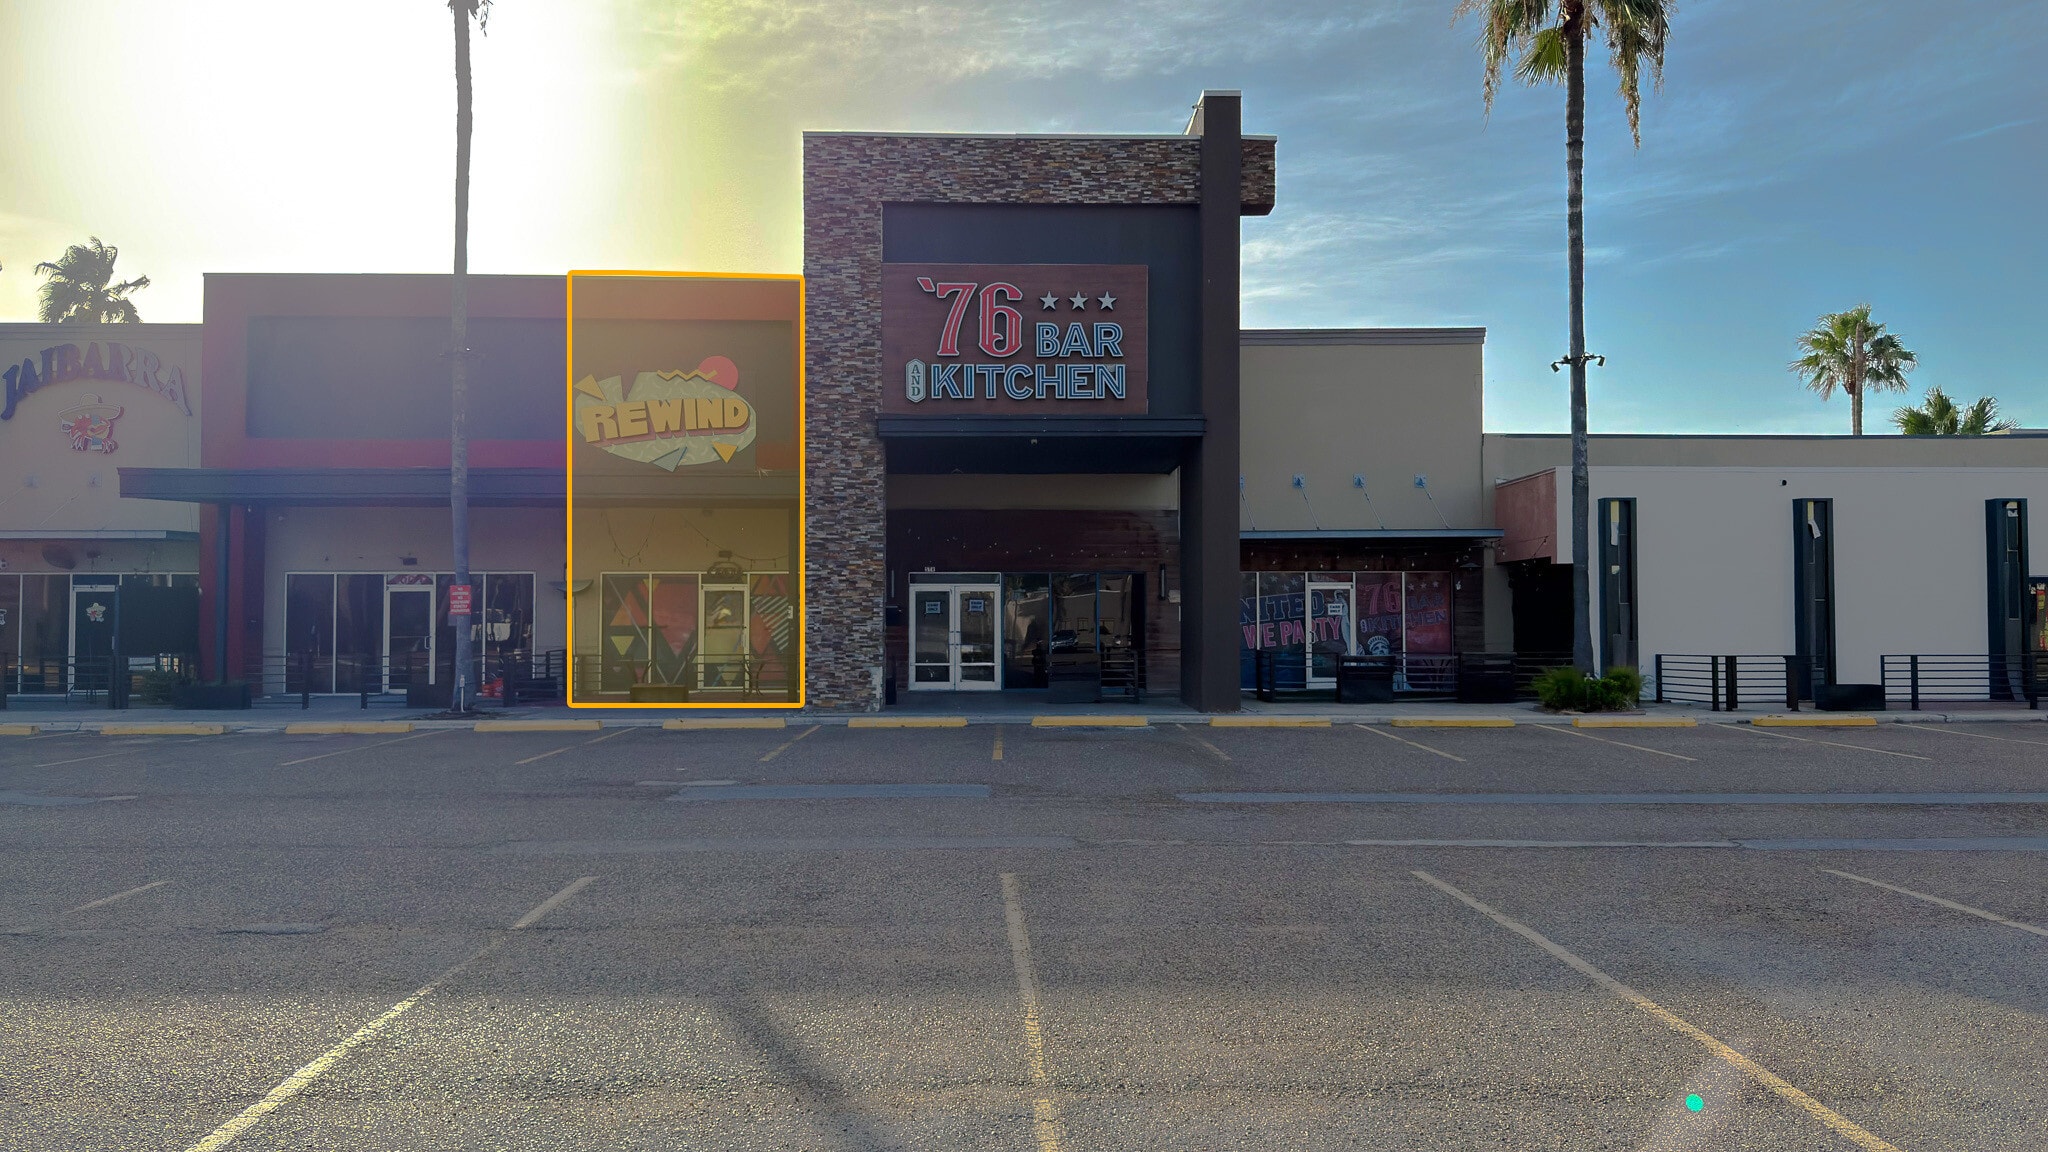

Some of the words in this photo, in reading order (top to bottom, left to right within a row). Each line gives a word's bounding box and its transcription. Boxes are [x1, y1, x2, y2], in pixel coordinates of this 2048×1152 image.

[917, 277, 1023, 357] '76
[1036, 322, 1123, 357] BAR
[1, 341, 192, 420] JAIBARRA
[910, 363, 921, 397] AND
[931, 364, 1125, 399] KITCHEN
[581, 399, 750, 444] REWIND
[1240, 591, 1324, 624] NITED
[1407, 593, 1444, 611] BAR
[1243, 623, 1277, 649] WE
[1280, 616, 1342, 646] PARTY
[1368, 609, 1449, 633] KITCHEN
